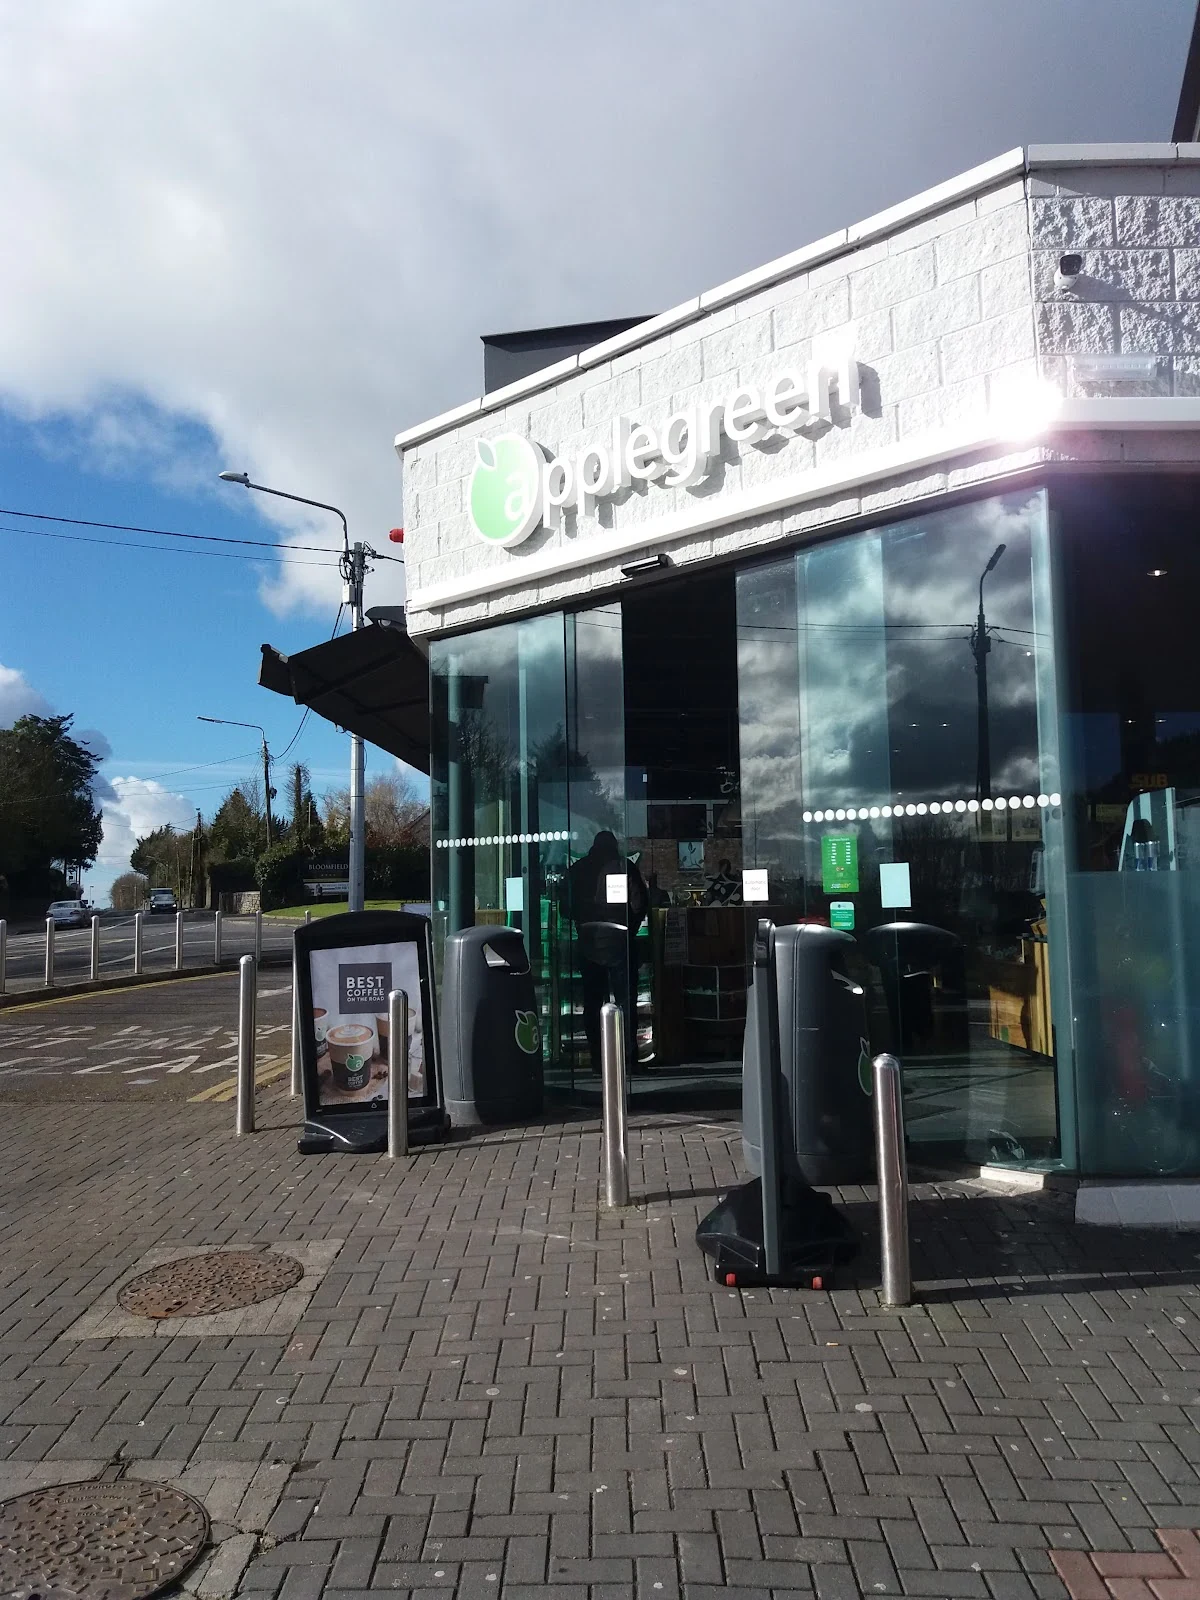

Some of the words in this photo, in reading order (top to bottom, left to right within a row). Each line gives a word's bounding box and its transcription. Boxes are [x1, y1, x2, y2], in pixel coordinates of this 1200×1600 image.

[503, 354, 858, 531] applegreen
[308, 863, 349, 871] BLOOMFIELD
[346, 975, 385, 989] BEST
[346, 988, 385, 997] COFFEE
